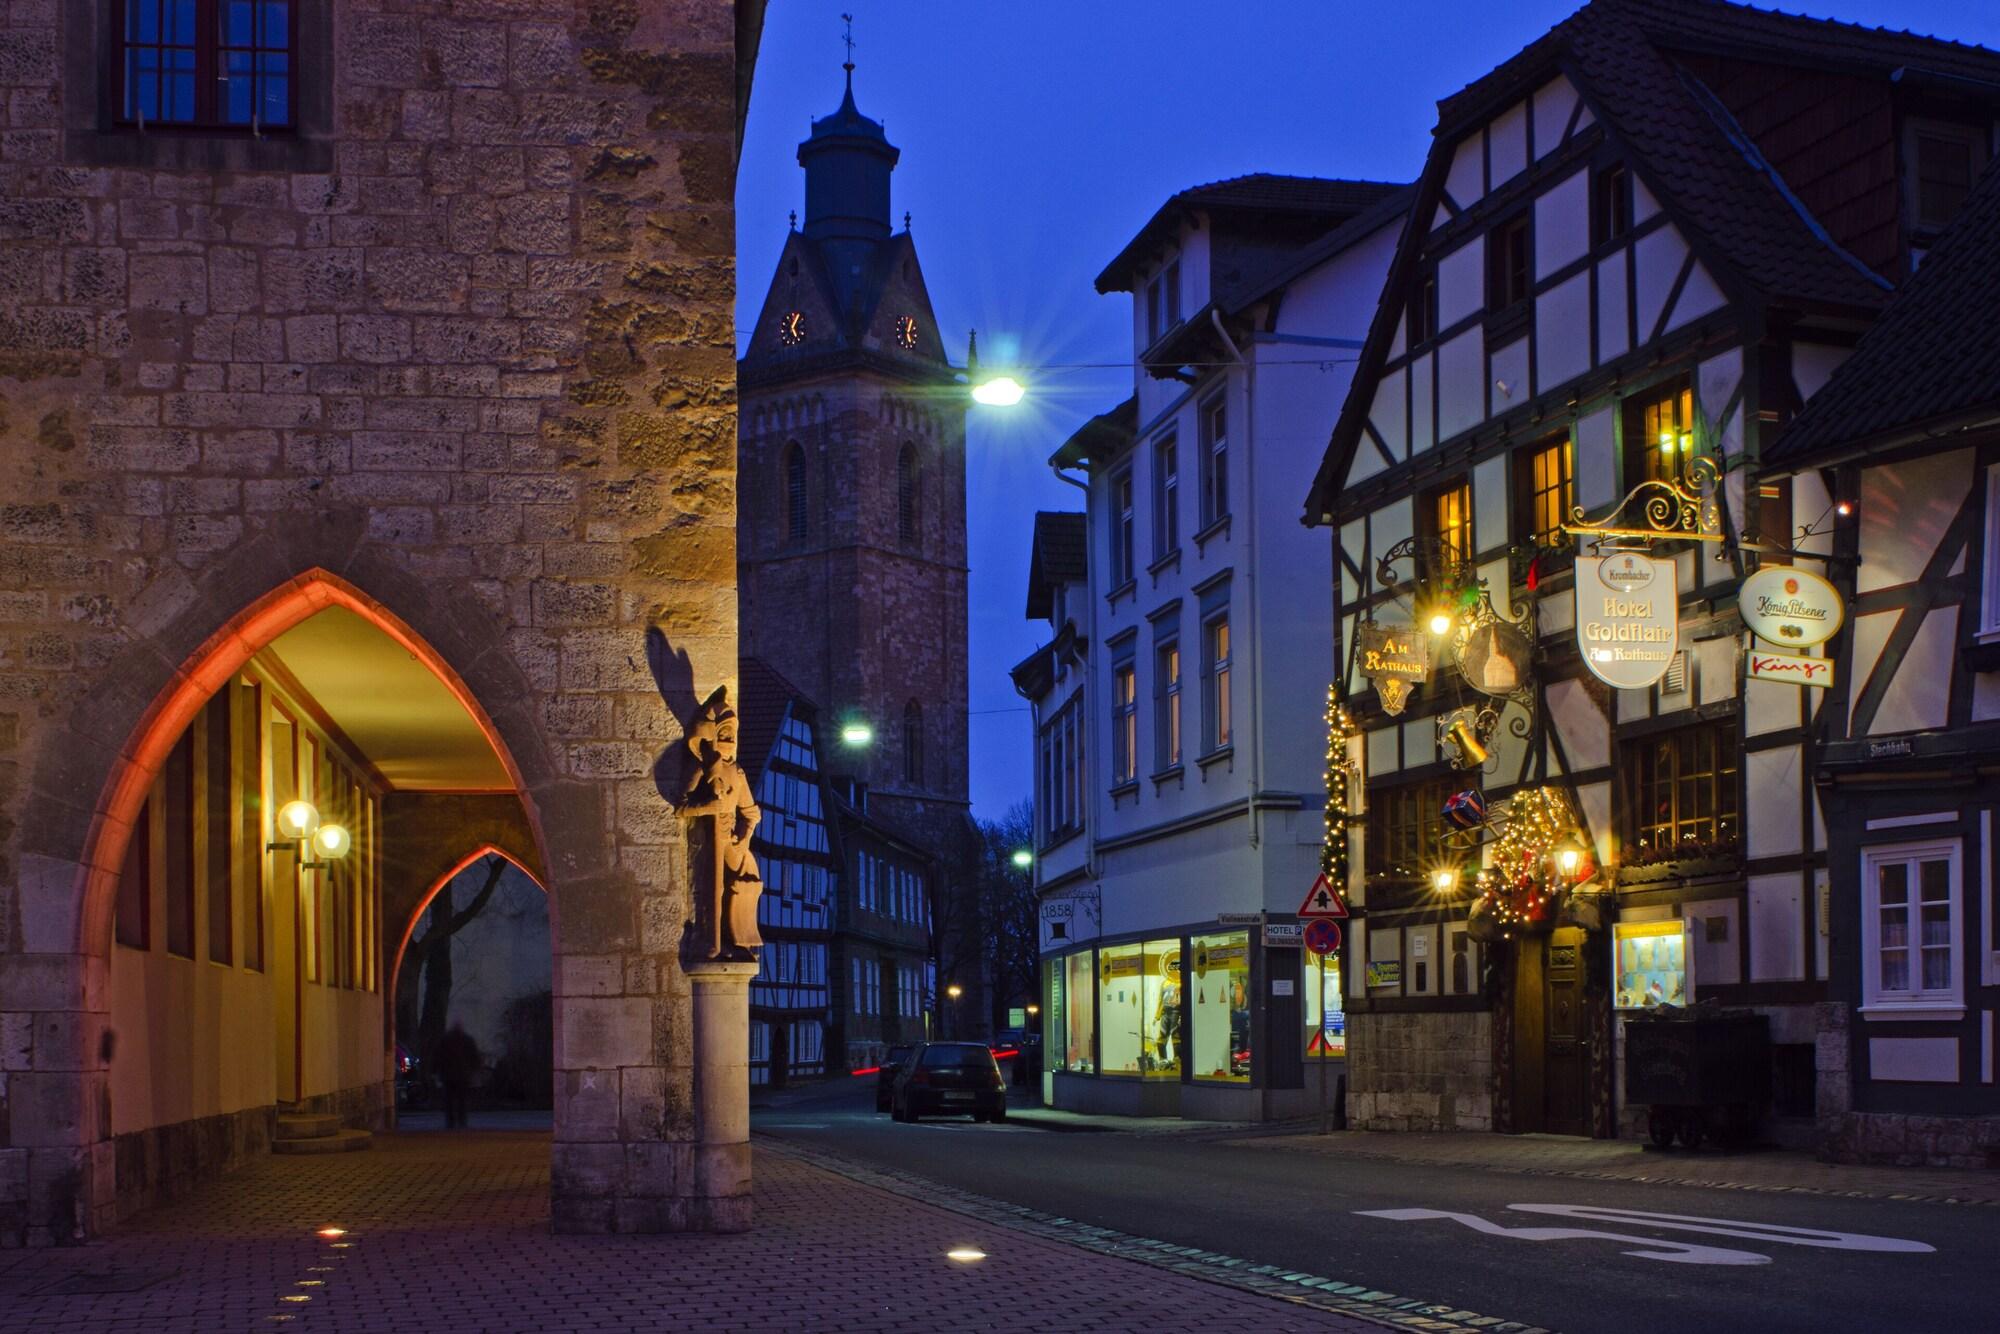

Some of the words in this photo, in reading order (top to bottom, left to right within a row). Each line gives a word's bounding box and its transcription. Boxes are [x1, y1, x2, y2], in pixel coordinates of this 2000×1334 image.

[1608, 569, 1650, 581] Krombacher
[1603, 597, 1653, 618] Hotel
[1757, 596, 1788, 616] König
[1787, 599, 1827, 618] Pilsener
[1585, 622, 1672, 642] Goldflair
[1365, 650, 1422, 673] RATHAUS
[1589, 647, 1612, 662] A
[1614, 647, 1667, 661] Rathaus
[1752, 655, 1827, 678] Kings
[1871, 740, 1911, 757] Stechbahn
[1044, 903, 1073, 918] 1858
[1267, 926, 1294, 935] HOTEL
